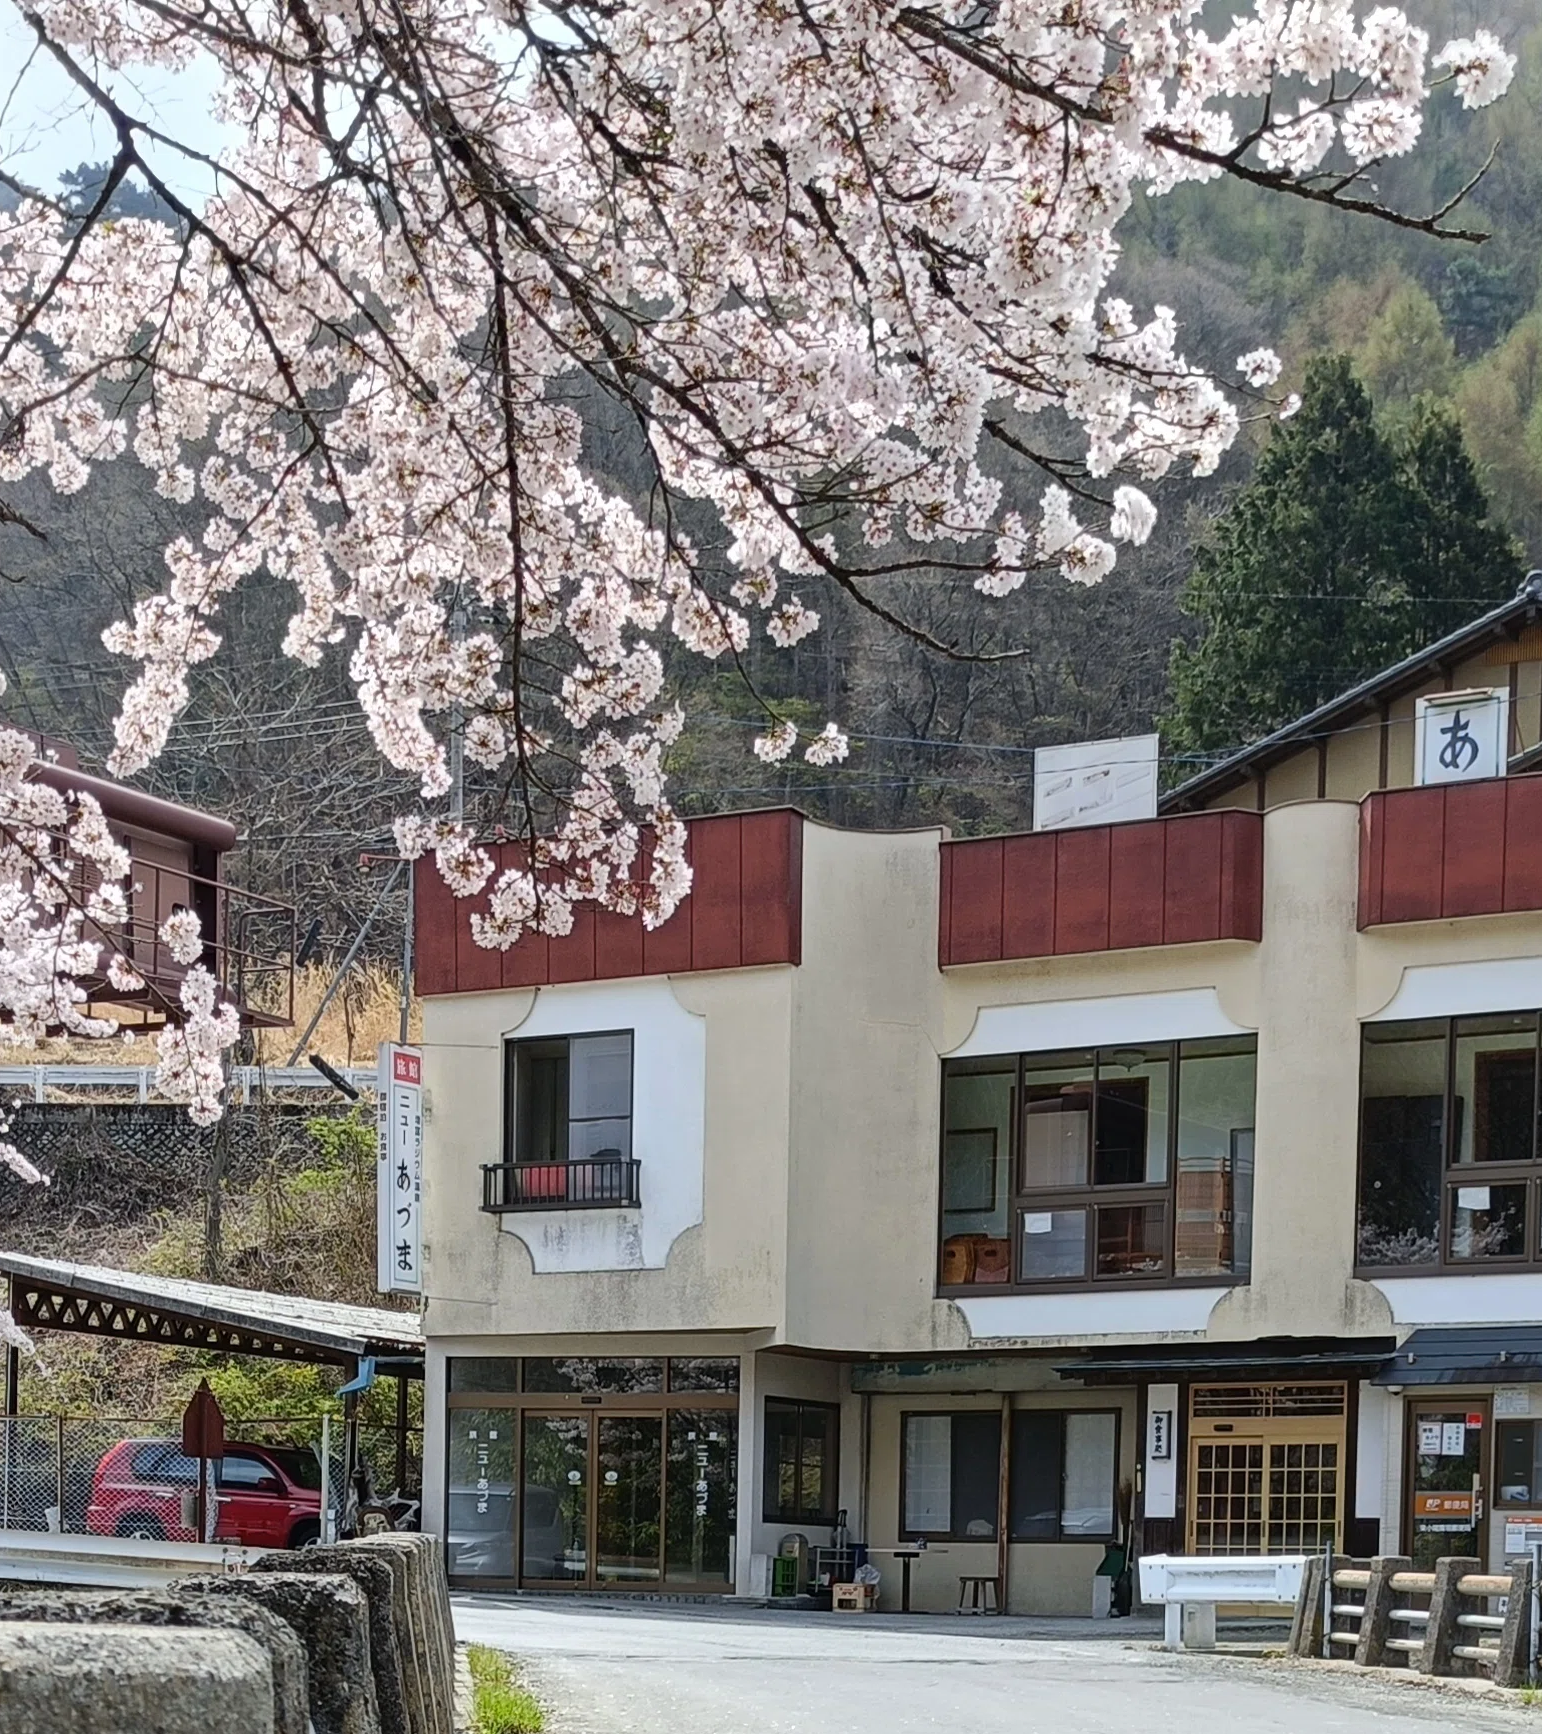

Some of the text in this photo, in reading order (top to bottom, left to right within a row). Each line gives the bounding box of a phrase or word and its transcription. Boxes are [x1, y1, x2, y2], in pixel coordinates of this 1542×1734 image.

[396, 1057, 419, 1080] 旅館
[396, 1095, 413, 1271] ニューあづま
[477, 1443, 490, 1514] ニューあづま
[696, 1445, 709, 1516] ニューあづま
